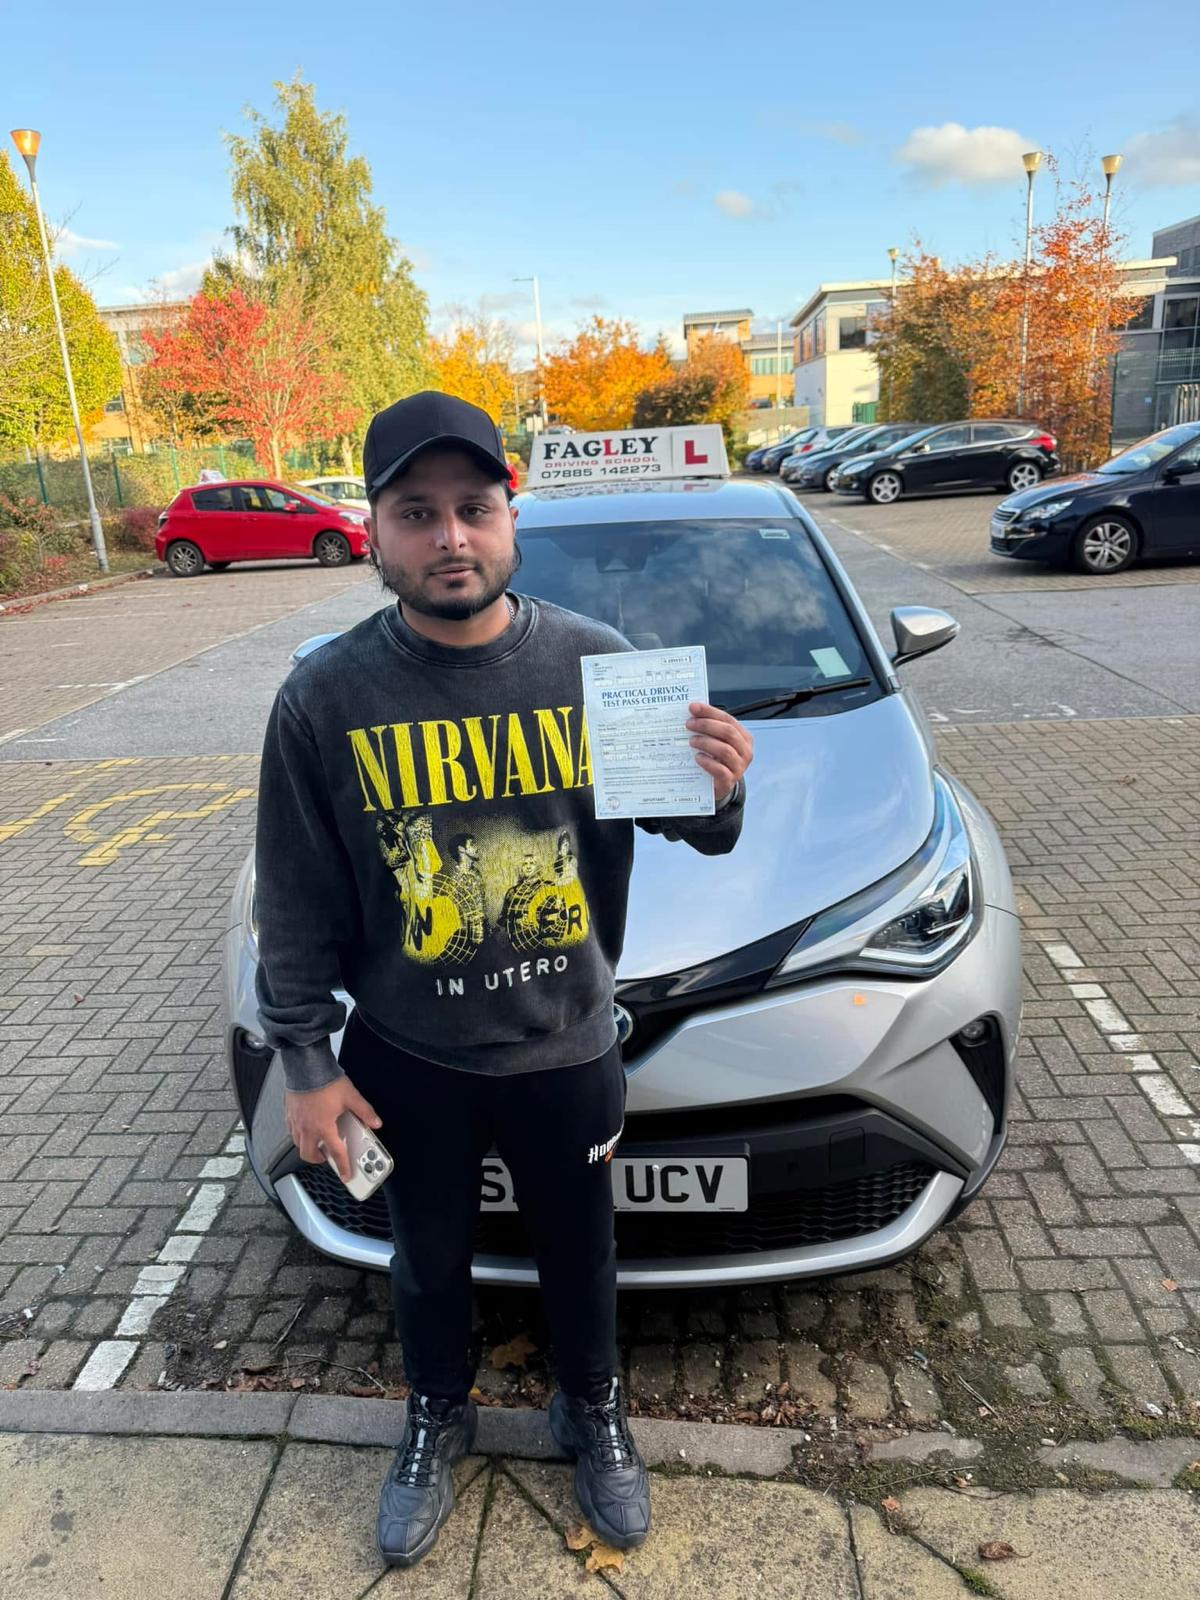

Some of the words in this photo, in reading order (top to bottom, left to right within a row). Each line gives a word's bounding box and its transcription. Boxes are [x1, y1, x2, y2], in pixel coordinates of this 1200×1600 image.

[543, 436, 659, 460] FAGLEY
[684, 439, 708, 465] L
[541, 467, 593, 480] 07885
[600, 463, 661, 476] 142273
[545, 459, 599, 469] DRIVING
[605, 456, 659, 466] SCHOOL
[601, 688, 649, 700] PRACTICAL
[650, 685, 690, 697] DRIVING
[603, 699, 620, 708] TEST
[622, 697, 641, 706] PASS
[641, 693, 690, 705] CERTIFICATE
[435, 977, 465, 996] IN
[484, 954, 568, 991] UTERO
[625, 1165, 724, 1203] UCV
